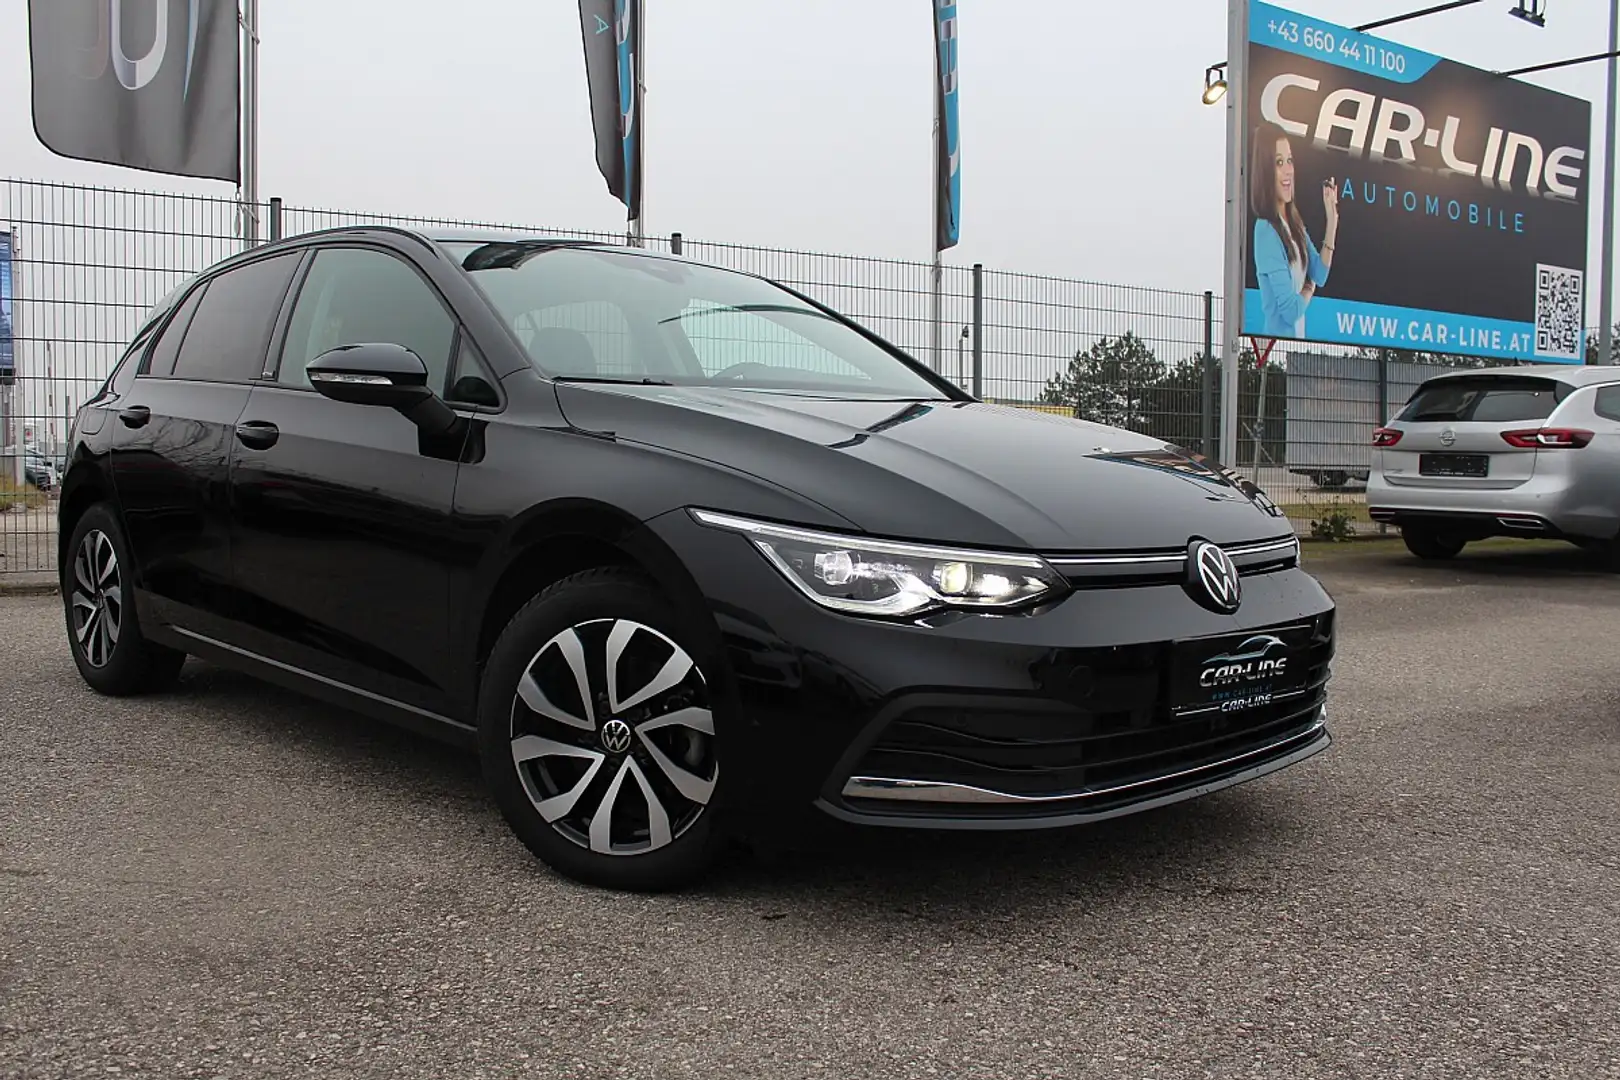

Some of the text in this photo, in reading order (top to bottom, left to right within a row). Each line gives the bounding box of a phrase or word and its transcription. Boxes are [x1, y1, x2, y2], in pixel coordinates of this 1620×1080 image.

[1267, 19, 1406, 74] +43 660 44 11 100
[1260, 73, 1585, 197] CAR-LINE
[1341, 178, 1525, 233] AUTOMOBILE
[1336, 311, 1531, 353] WWW.CAR-LINE.AT
[1199, 657, 1288, 687] CAR-LINE
[1221, 693, 1272, 712] CAR-LINE
